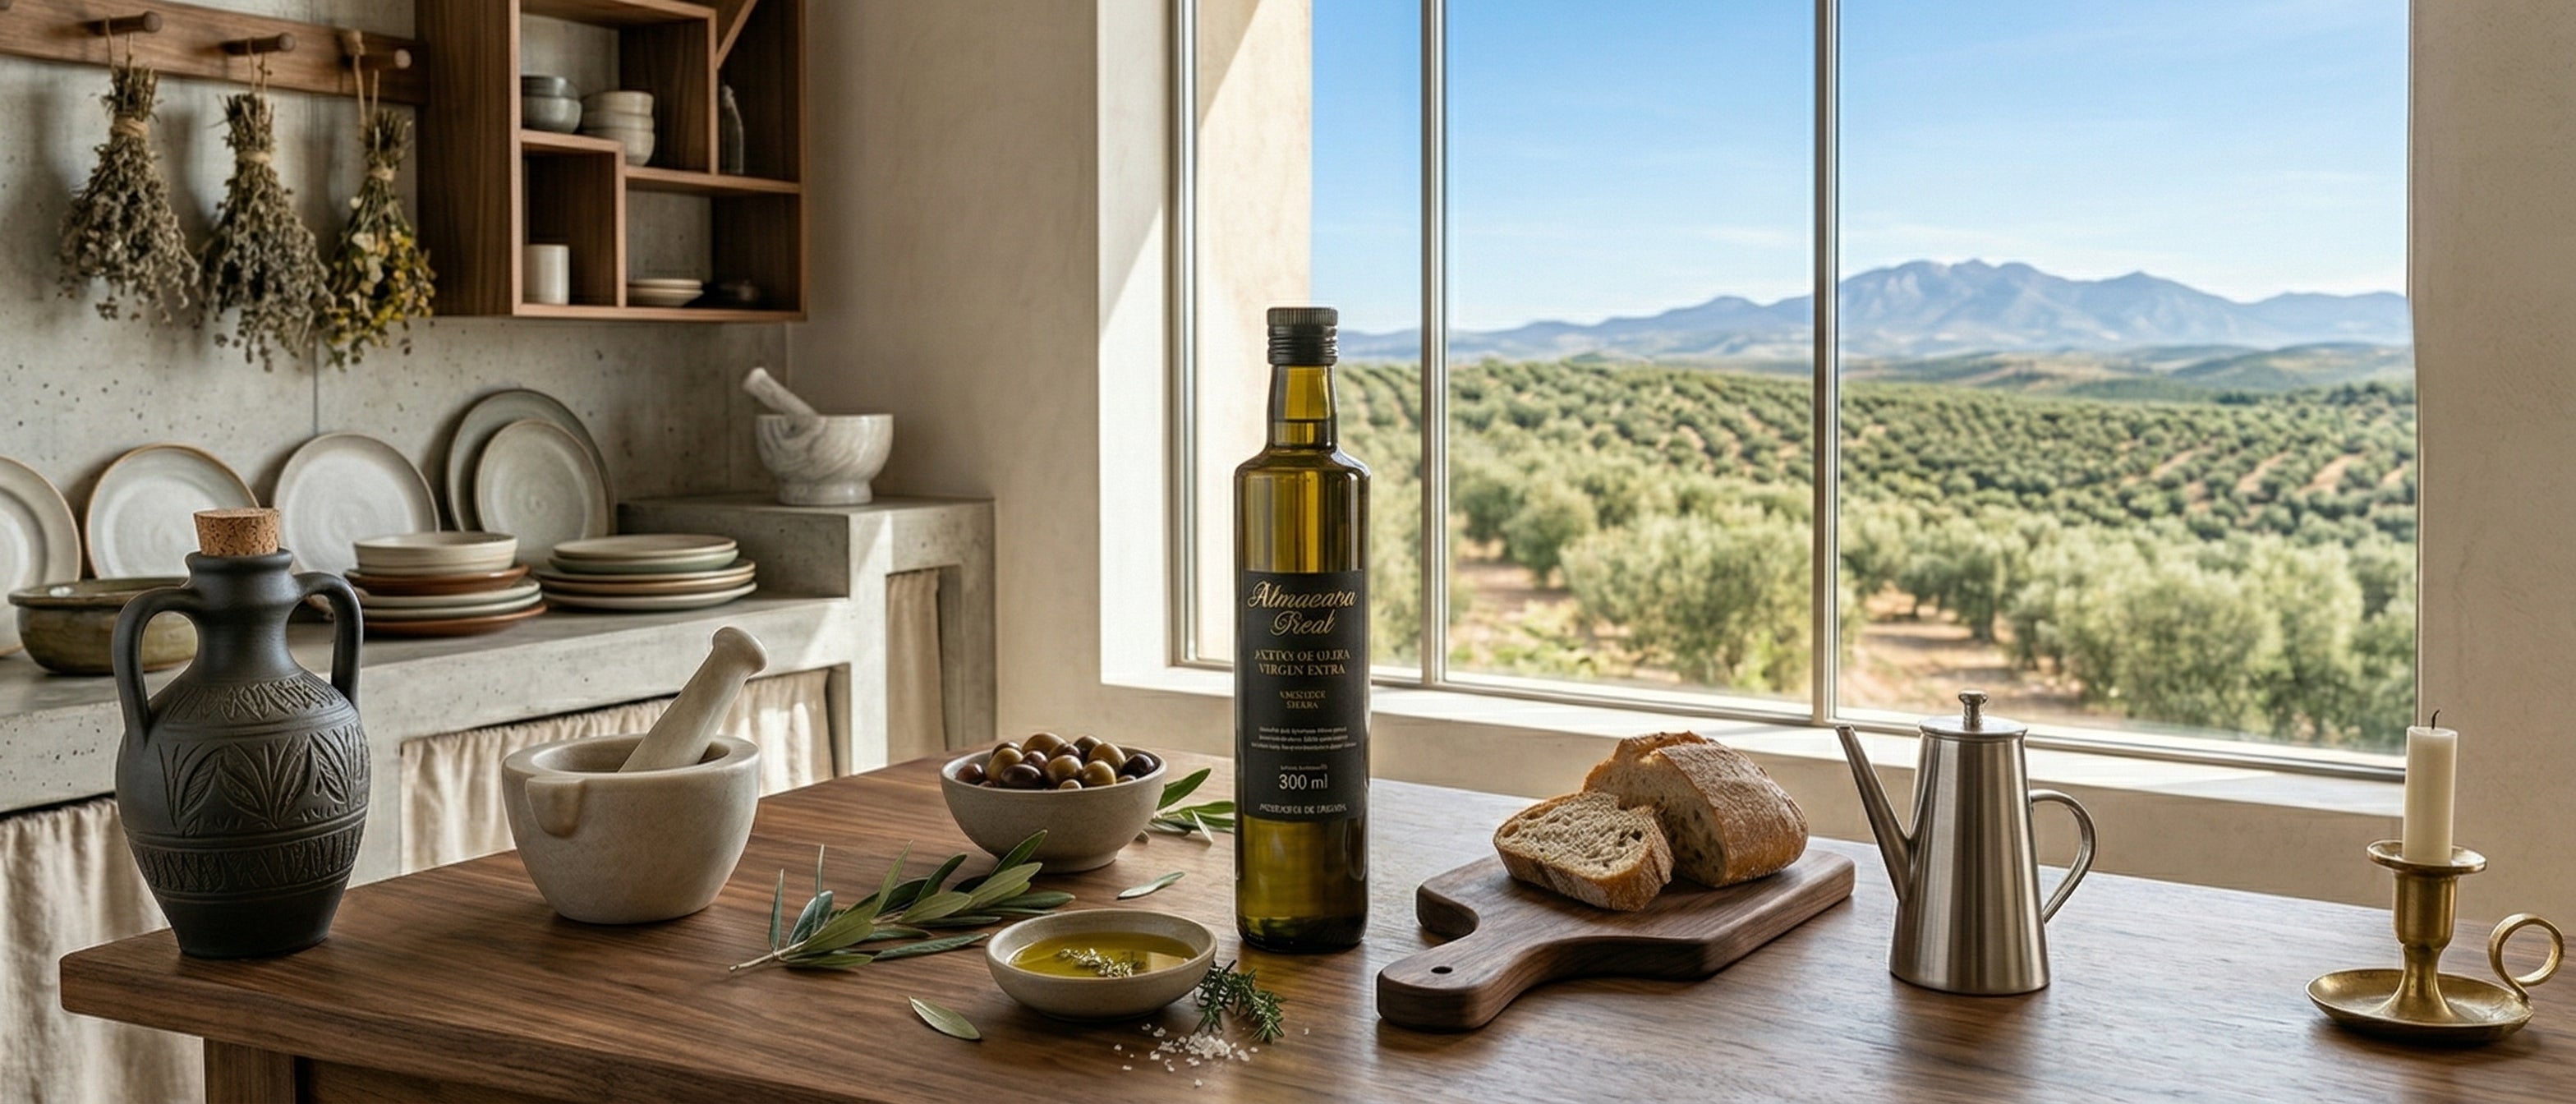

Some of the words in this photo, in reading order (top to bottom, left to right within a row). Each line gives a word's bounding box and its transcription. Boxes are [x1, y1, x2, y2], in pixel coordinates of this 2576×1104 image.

[1308, 664, 1346, 676] EXTRA
[1278, 774, 1307, 790] 300
[1311, 773, 1328, 789] ml
